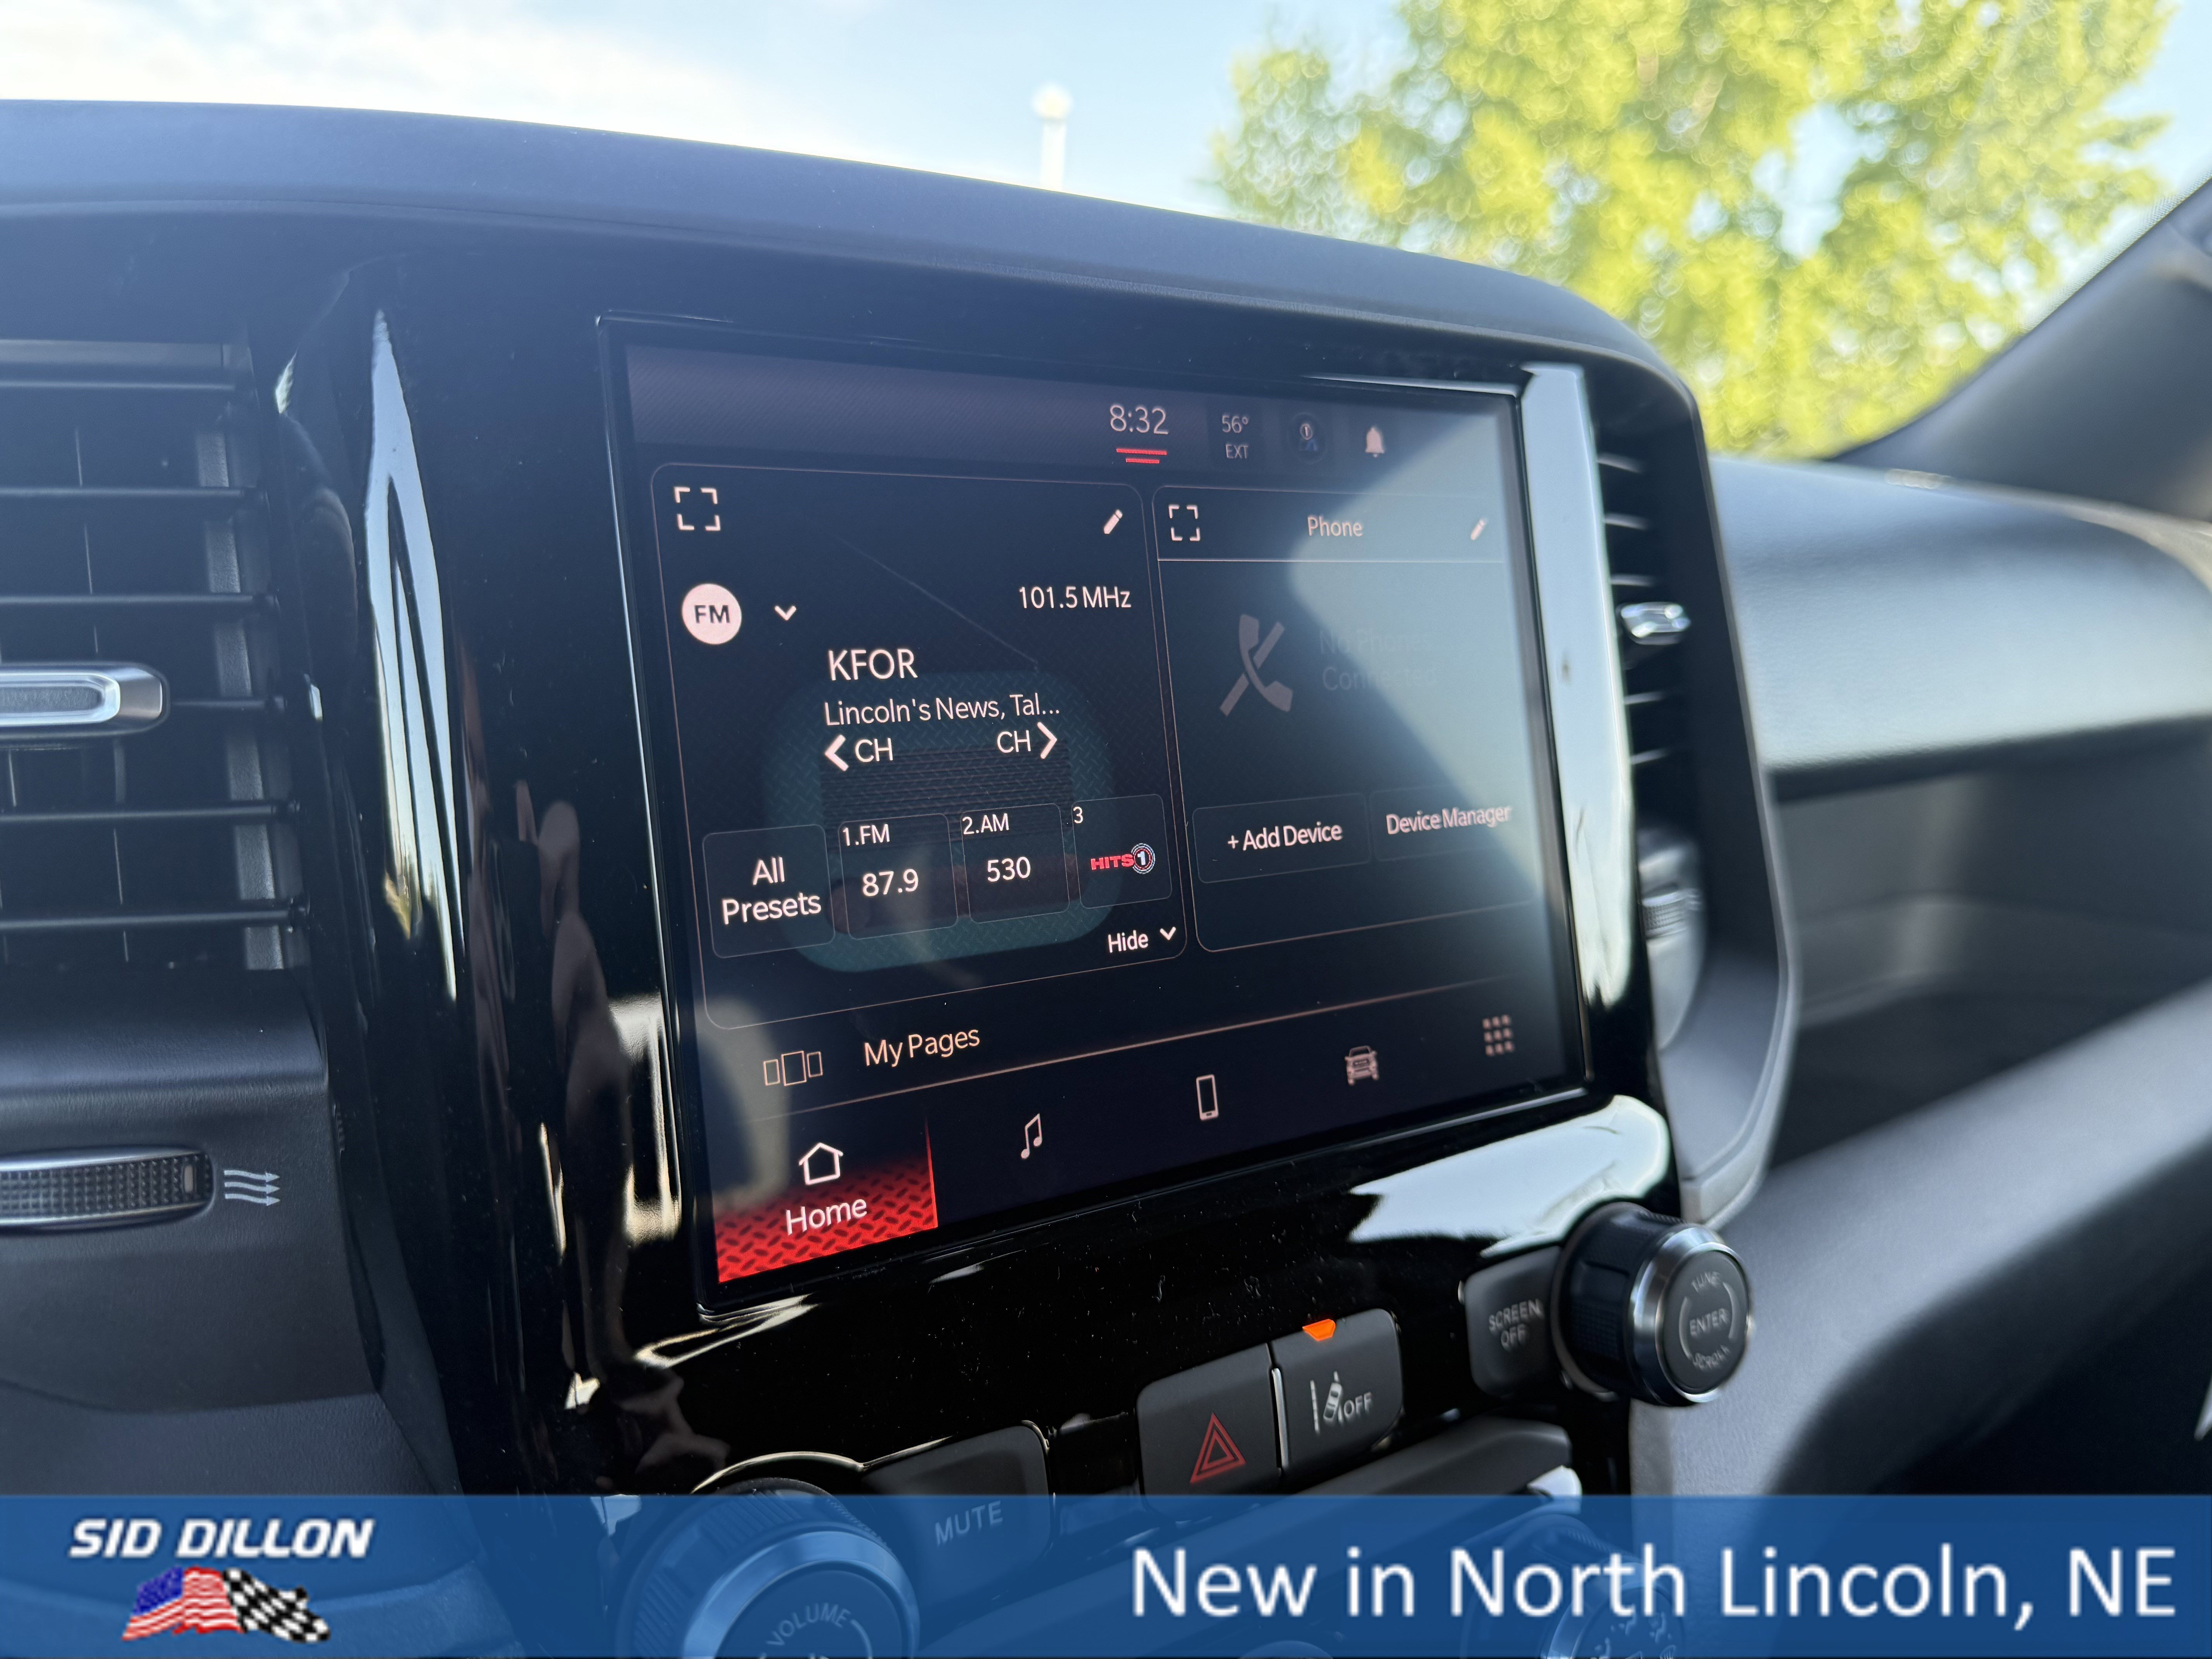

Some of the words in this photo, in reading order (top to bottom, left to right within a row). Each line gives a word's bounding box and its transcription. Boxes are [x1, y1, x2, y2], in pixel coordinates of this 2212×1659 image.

[1109, 404, 1169, 435] 8:32
[1222, 414, 1249, 433] 56°
[1226, 444, 1249, 459] EXT
[1307, 516, 1363, 538] Phone
[1018, 586, 1079, 610] 101.5
[1082, 588, 1132, 610] MHz
[693, 603, 730, 625] FM
[828, 648, 919, 681] KFOR
[824, 698, 931, 726] Lincoln's
[935, 697, 1005, 721] News,
[1009, 692, 1060, 716] Tal...
[854, 737, 894, 763] CH
[996, 729, 1032, 754] CH
[961, 812, 1010, 836] 2.AM
[1073, 806, 1084, 824] 3
[1386, 809, 1441, 835] Device
[1441, 804, 1512, 829] Manager
[842, 823, 891, 847] 1.FM
[1243, 826, 1279, 851] Add
[1283, 821, 1343, 847] Device
[752, 857, 785, 886] All
[861, 867, 919, 897] 87.9
[986, 856, 1031, 882] 530
[721, 892, 822, 926] Presets
[1107, 931, 1149, 954] Hide
[864, 1037, 903, 1067] My
[908, 1027, 981, 1058] Pages
[785, 1197, 868, 1236] Home
[1489, 1298, 1543, 1334] SCREEN
[1689, 1308, 1729, 1338] ENTER
[1501, 1324, 1528, 1352] OFF
[1343, 1392, 1372, 1418] OFF
[935, 1500, 1005, 1546] MUTE
[765, 1602, 851, 1646] VOLUME
